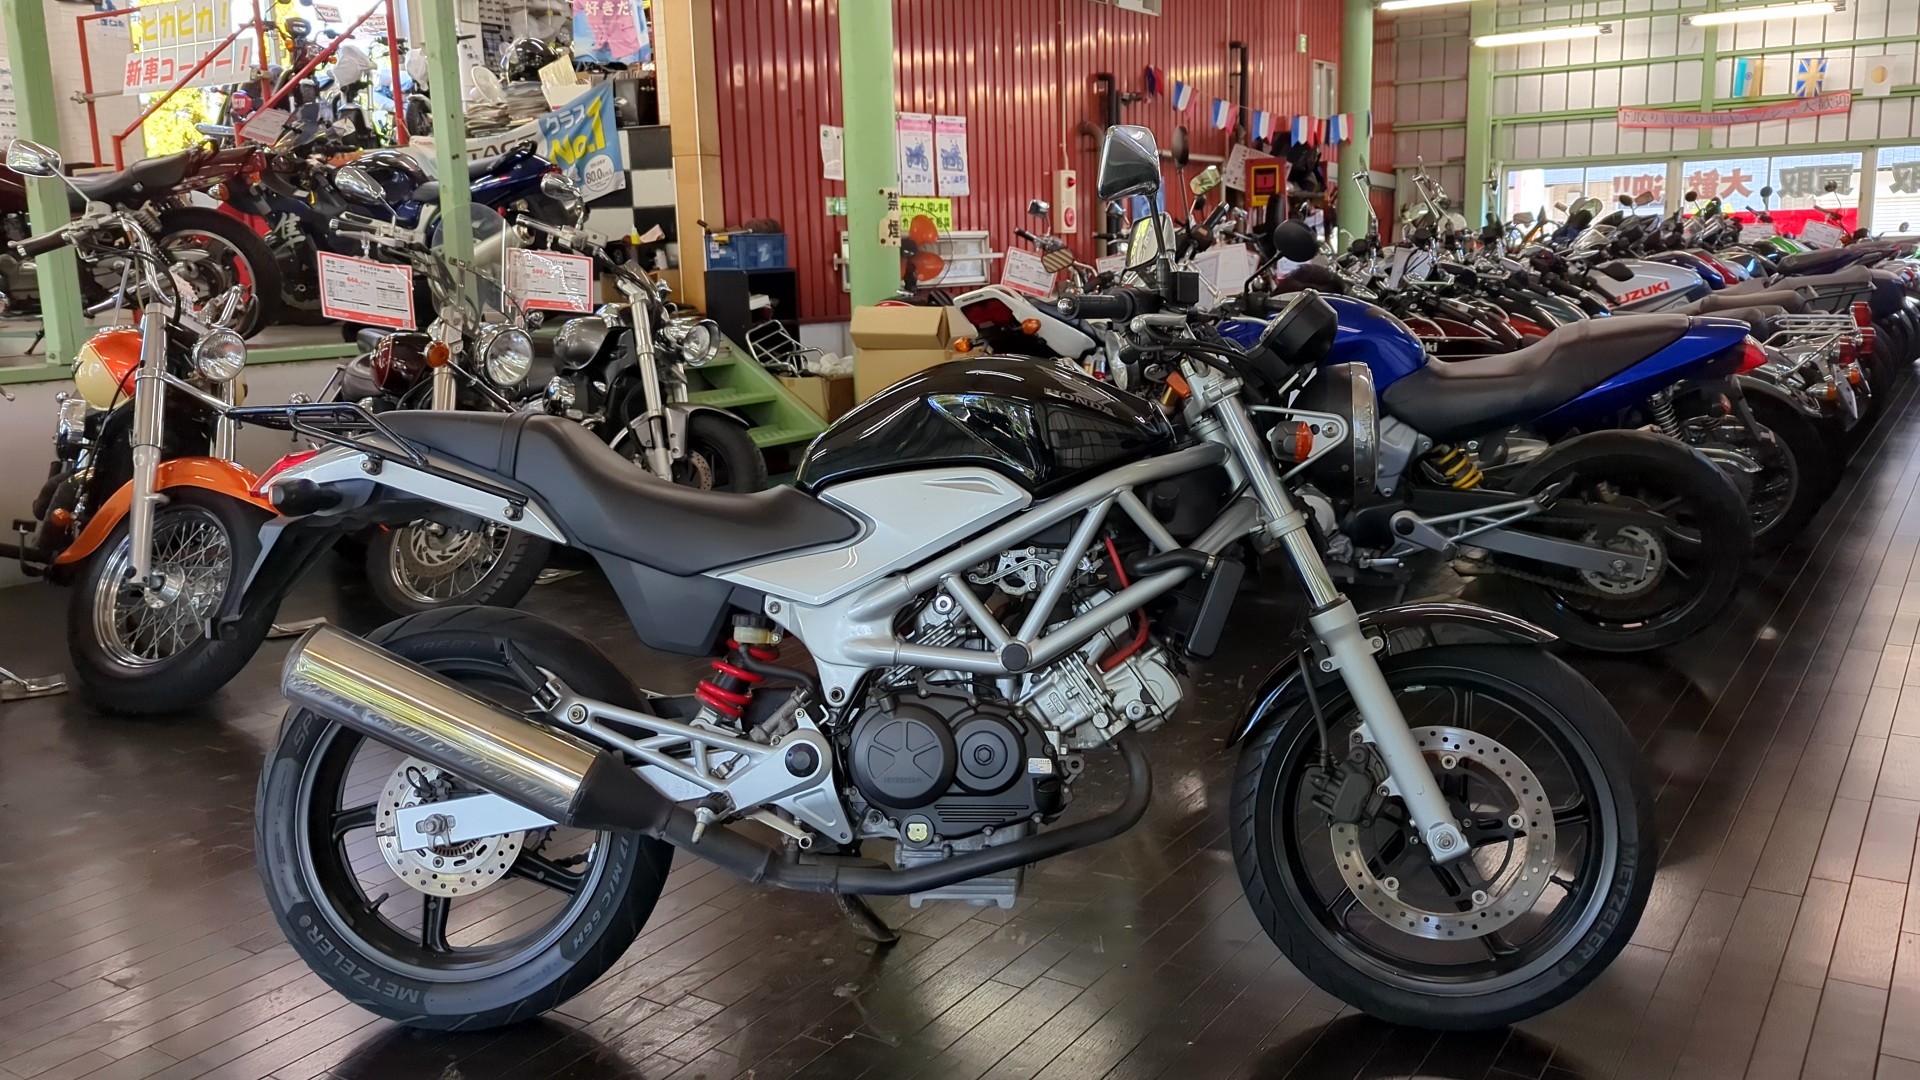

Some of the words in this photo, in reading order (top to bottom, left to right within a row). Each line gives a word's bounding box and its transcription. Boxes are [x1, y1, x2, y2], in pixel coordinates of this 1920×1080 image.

[545, 103, 586, 134] クラス
[551, 96, 606, 165] No.1
[1043, 387, 1117, 418] HONDA
[306, 925, 420, 1004] METZELER
